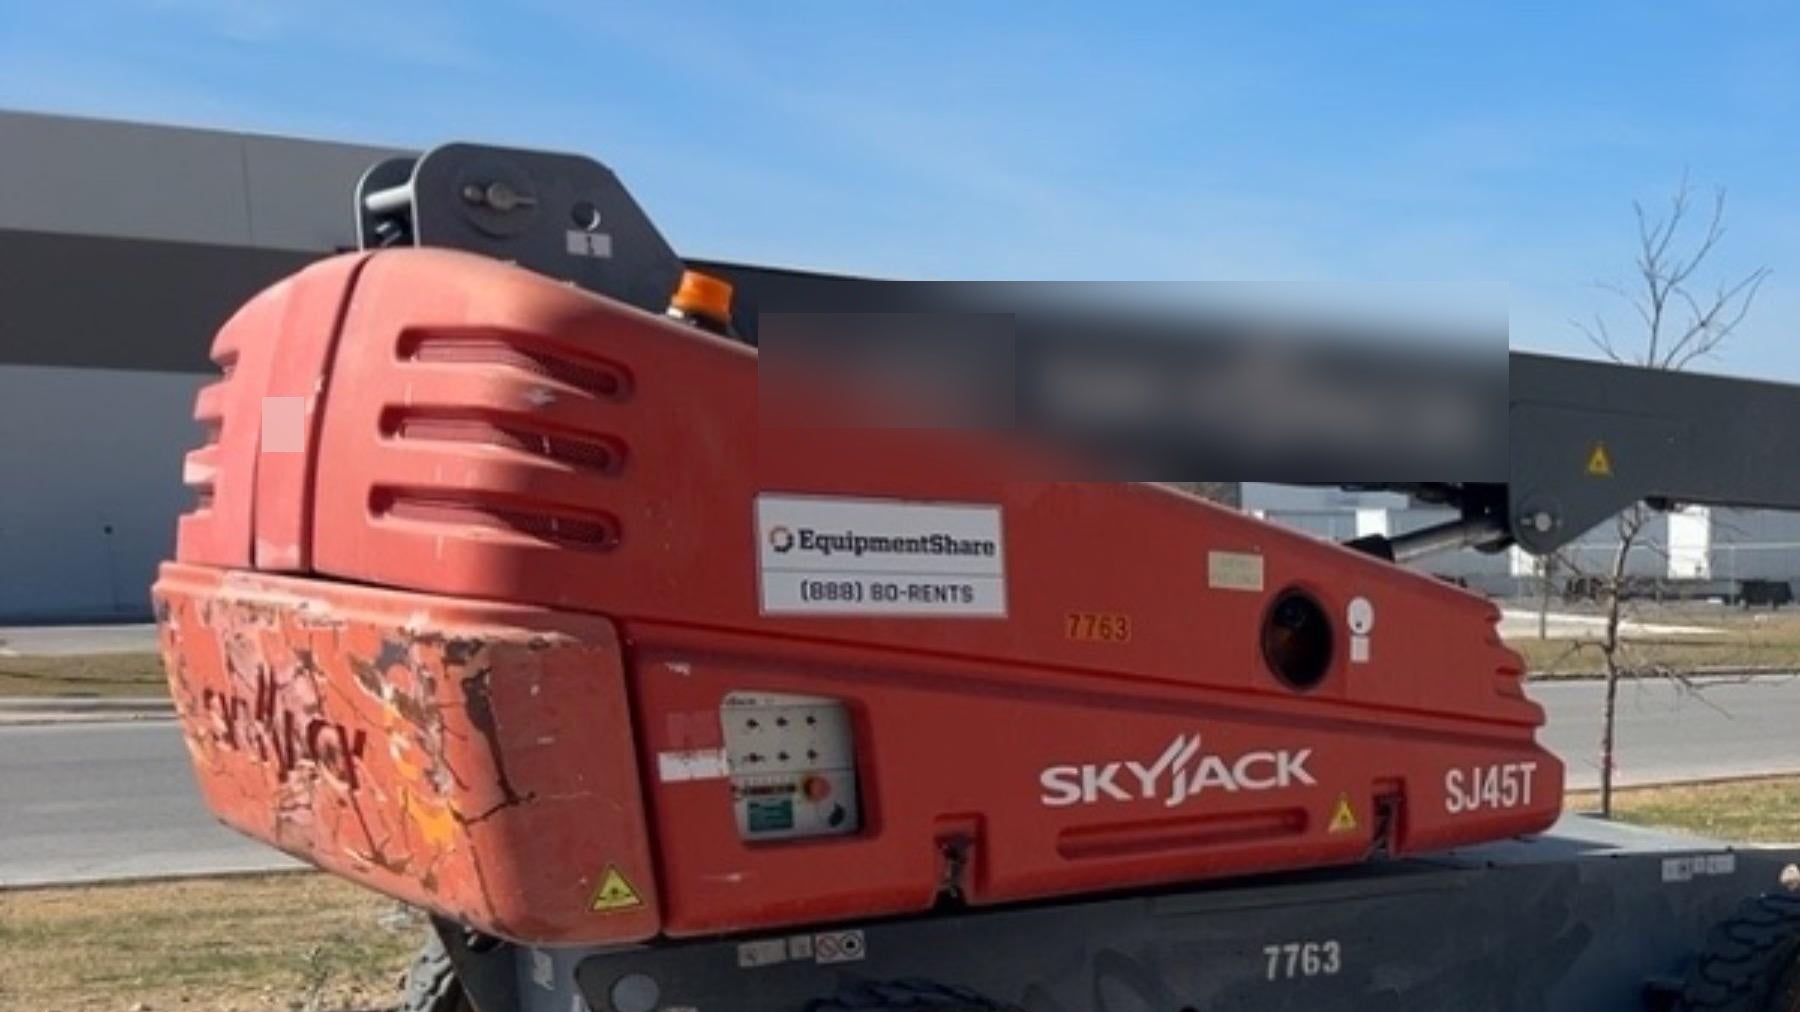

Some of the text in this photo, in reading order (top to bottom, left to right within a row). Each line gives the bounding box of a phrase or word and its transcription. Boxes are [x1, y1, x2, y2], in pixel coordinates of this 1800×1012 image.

[797, 529, 996, 557] EquipmentShare
[800, 579, 863, 603] (888)
[1067, 613, 1131, 642] 7763
[1040, 733, 1317, 808] SKYJACK
[1444, 762, 1537, 814] SJ45T
[1262, 940, 1341, 981] 7763
